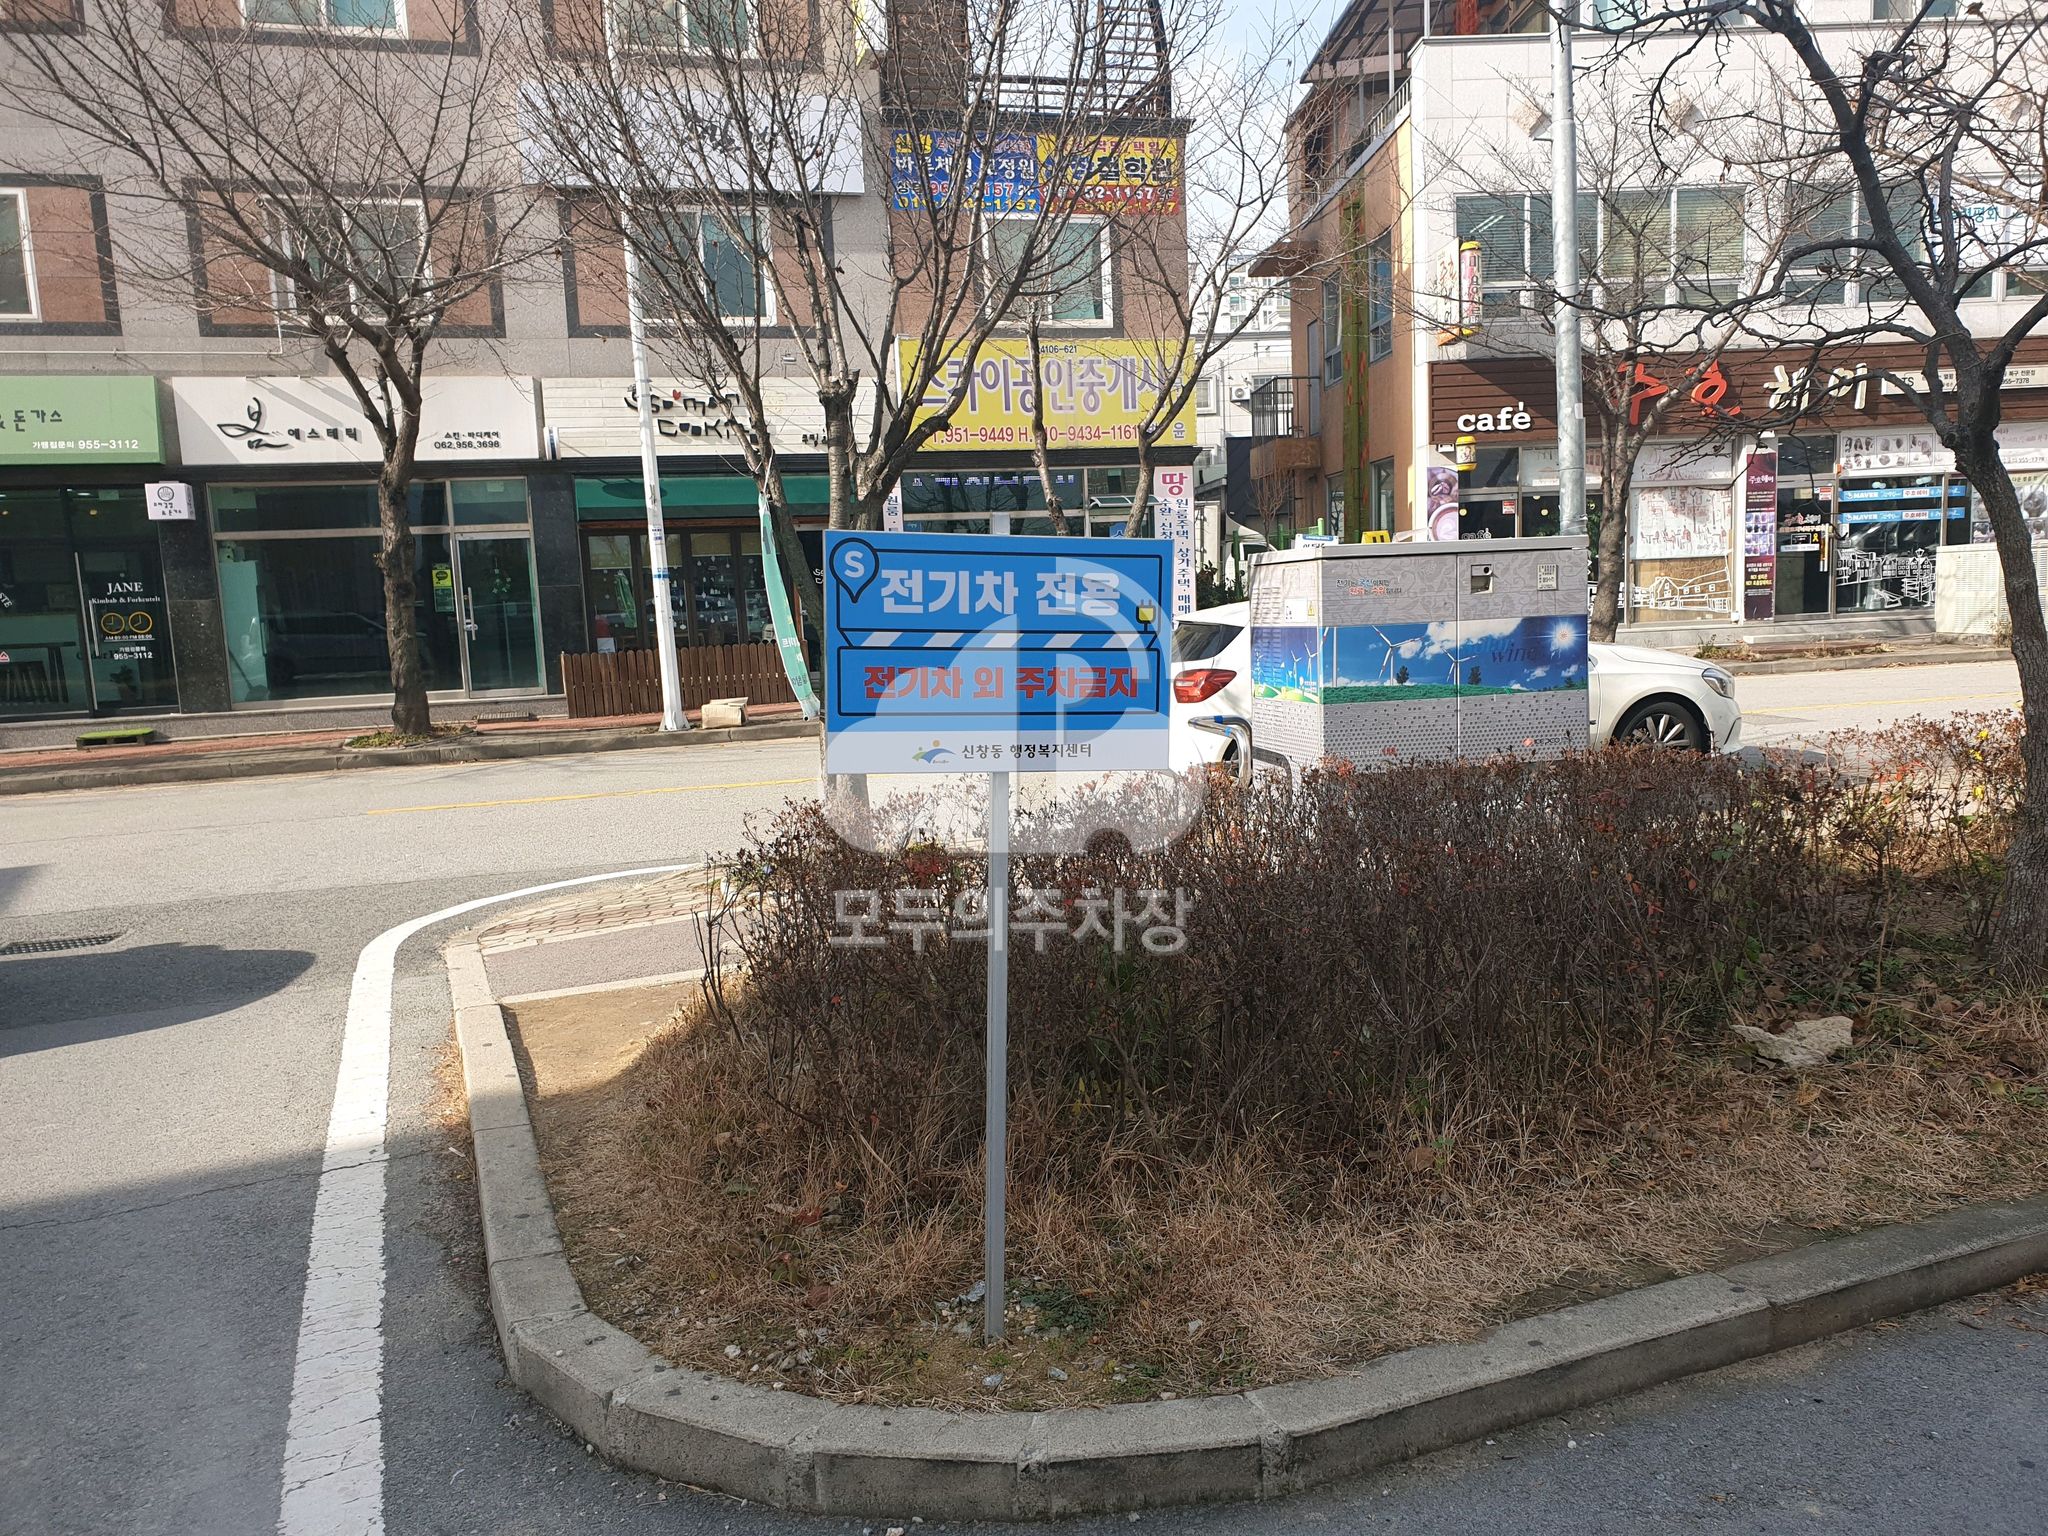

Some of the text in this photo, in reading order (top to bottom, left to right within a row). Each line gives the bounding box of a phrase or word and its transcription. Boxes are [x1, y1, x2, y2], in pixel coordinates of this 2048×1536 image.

[13, 410, 63, 432] 돈가스
[1456, 401, 1532, 432] café
[78, 439, 139, 449] 955-3112
[1161, 472, 1188, 496] 땅
[1853, 491, 1879, 499] NAVER
[844, 550, 865, 578] S
[107, 581, 143, 595] JANE
[880, 568, 1121, 617] 전기차 전용
[113, 651, 153, 660] 955-3112
[863, 665, 1138, 700] 전기차 외 주차금지
[961, 742, 1092, 760] 신창동 행정복지센터
